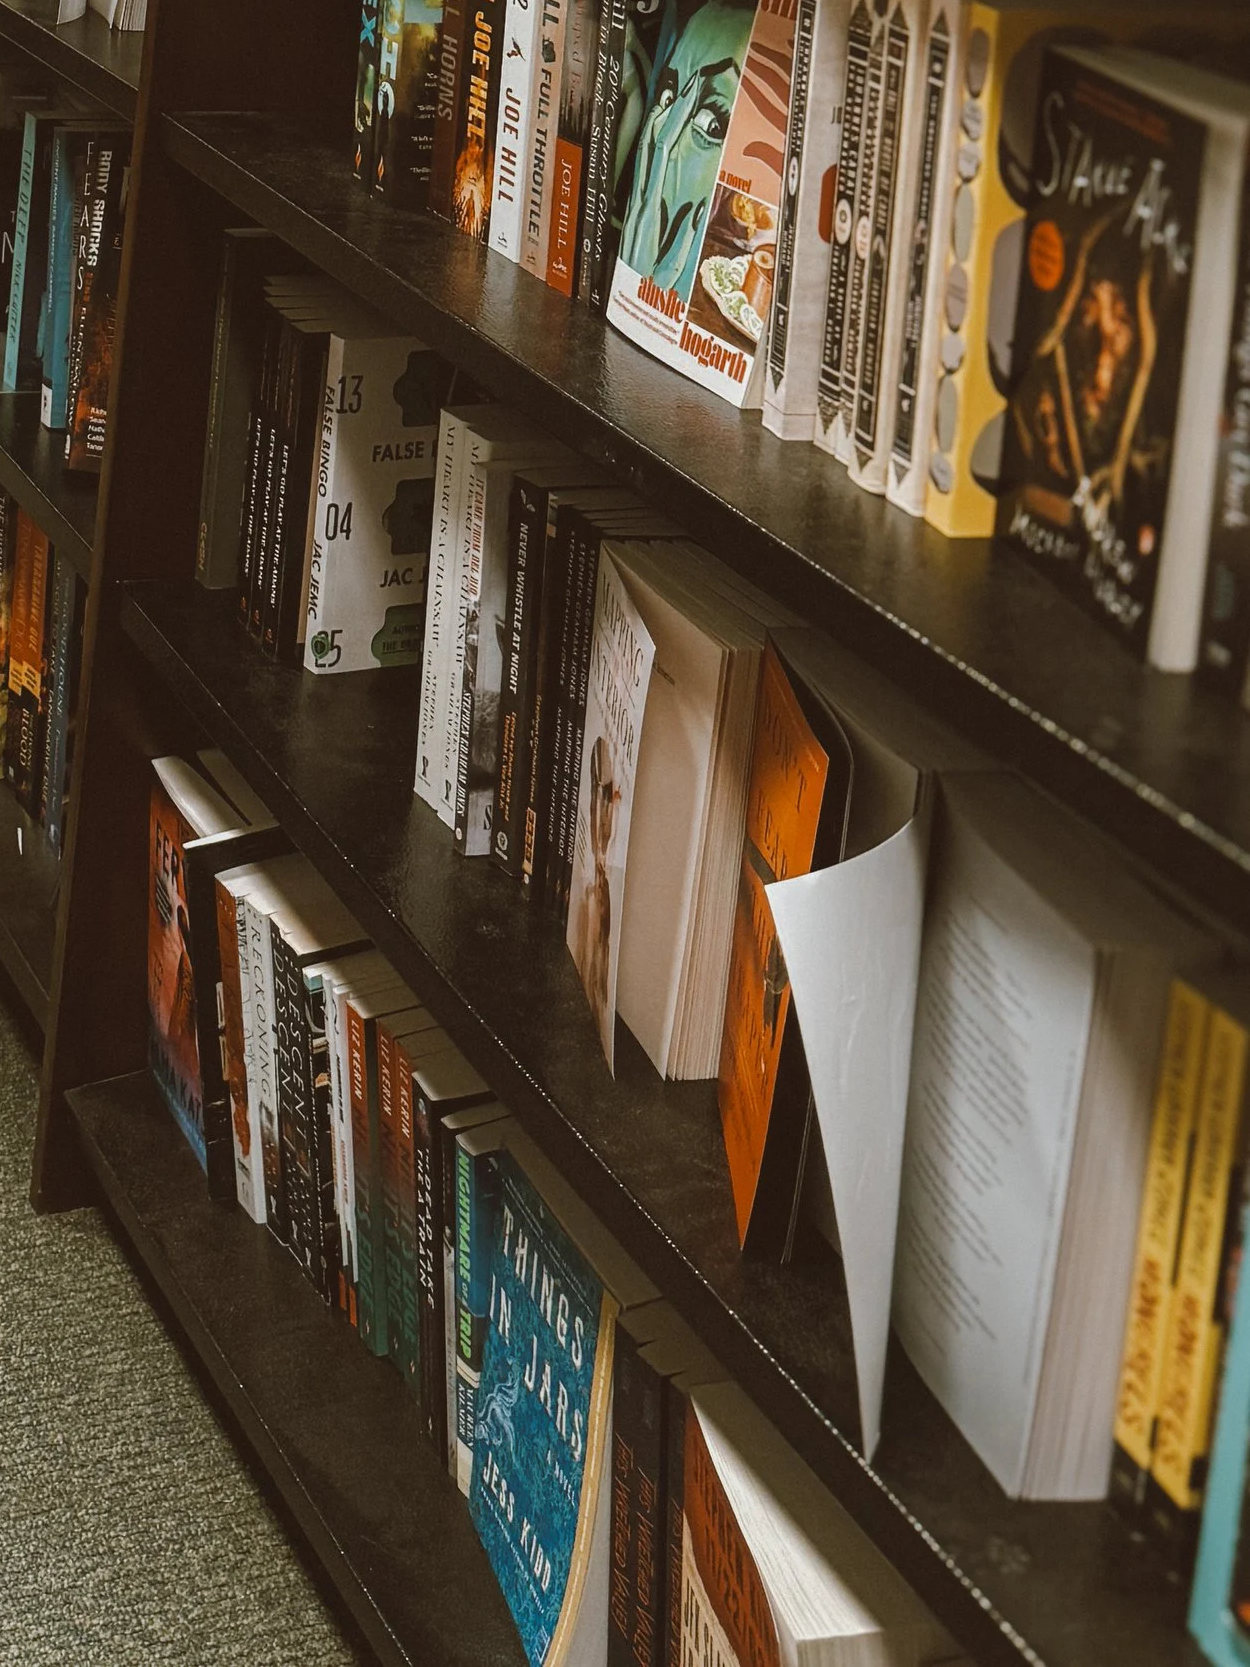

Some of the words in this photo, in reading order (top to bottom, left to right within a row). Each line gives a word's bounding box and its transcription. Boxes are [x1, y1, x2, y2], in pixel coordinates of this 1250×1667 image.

[468, 11, 492, 72] JOE
[436, 33, 459, 123] HORNS
[533, 67, 552, 124] FULL
[593, 50, 607, 106] Black
[464, 75, 490, 140] HILL
[501, 86, 522, 144] JOE
[588, 124, 600, 179] Susan
[597, 100, 616, 188] Century
[496, 148, 519, 203] HILL
[525, 126, 549, 237] THROTTLE
[560, 157, 573, 197] JOE
[725, 170, 752, 195] novel
[13, 191, 30, 244] DEEP
[76, 141, 95, 291] FEARS
[85, 198, 105, 267] SHOCKS
[556, 202, 571, 251] HILL
[591, 192, 609, 262] Ghosts
[636, 273, 686, 325] ainslie
[678, 320, 749, 386] hogarth
[323, 385, 335, 436] FALSE
[335, 374, 365, 414] 13
[317, 439, 330, 499] BINGO
[371, 441, 425, 463] FALSE
[276, 496, 284, 524] PLAY
[279, 477, 285, 494] GO
[439, 454, 454, 511] HEART
[473, 491, 483, 519] CAME
[324, 501, 354, 542] 04
[471, 523, 481, 552] FROM
[518, 522, 529, 567] NEVER
[272, 543, 280, 563] THE
[308, 538, 321, 572] JAC
[379, 567, 413, 589] JAC
[306, 574, 318, 620] JEMC
[427, 551, 448, 641] CHAINSAW
[513, 567, 525, 631] WHISTLE
[512, 632, 521, 649] AT
[508, 650, 520, 695] NIGHT
[16, 708, 31, 765] BLOOD
[459, 689, 472, 736] STEPHEN
[456, 737, 470, 783] GRAHAM
[571, 727, 584, 782] MAPPING
[454, 783, 466, 816] JONES
[565, 809, 578, 865] INTERIOR
[248, 925, 273, 1094] RECKONING
[272, 948, 293, 1117] DESCENT
[350, 1019, 360, 1048] LIZ
[285, 972, 308, 1143] DESCENT
[350, 1048, 364, 1101] KERIN
[379, 1033, 390, 1063] LIZ
[398, 1057, 409, 1085] LIZ
[379, 1067, 393, 1116] KERIN
[398, 1088, 411, 1139] KERIN
[415, 1149, 424, 1185] THE
[422, 1173, 434, 1241] DEAD
[456, 1149, 471, 1280] NIGHTMARE
[415, 1213, 429, 1287] TRAIN
[424, 1246, 436, 1310] TAKE
[501, 1202, 586, 1374] THINGS
[459, 1308, 472, 1359] TRIP
[488, 1271, 512, 1348] IN
[523, 1333, 585, 1465] JARS
[482, 1448, 517, 1525] JESS
[552, 1456, 578, 1510] NOVEL
[611, 1476, 632, 1568] WRETCHED
[520, 1517, 553, 1595] KIDD
[633, 1513, 657, 1606] WRETCHED
[610, 1568, 629, 1637] VALLEY
